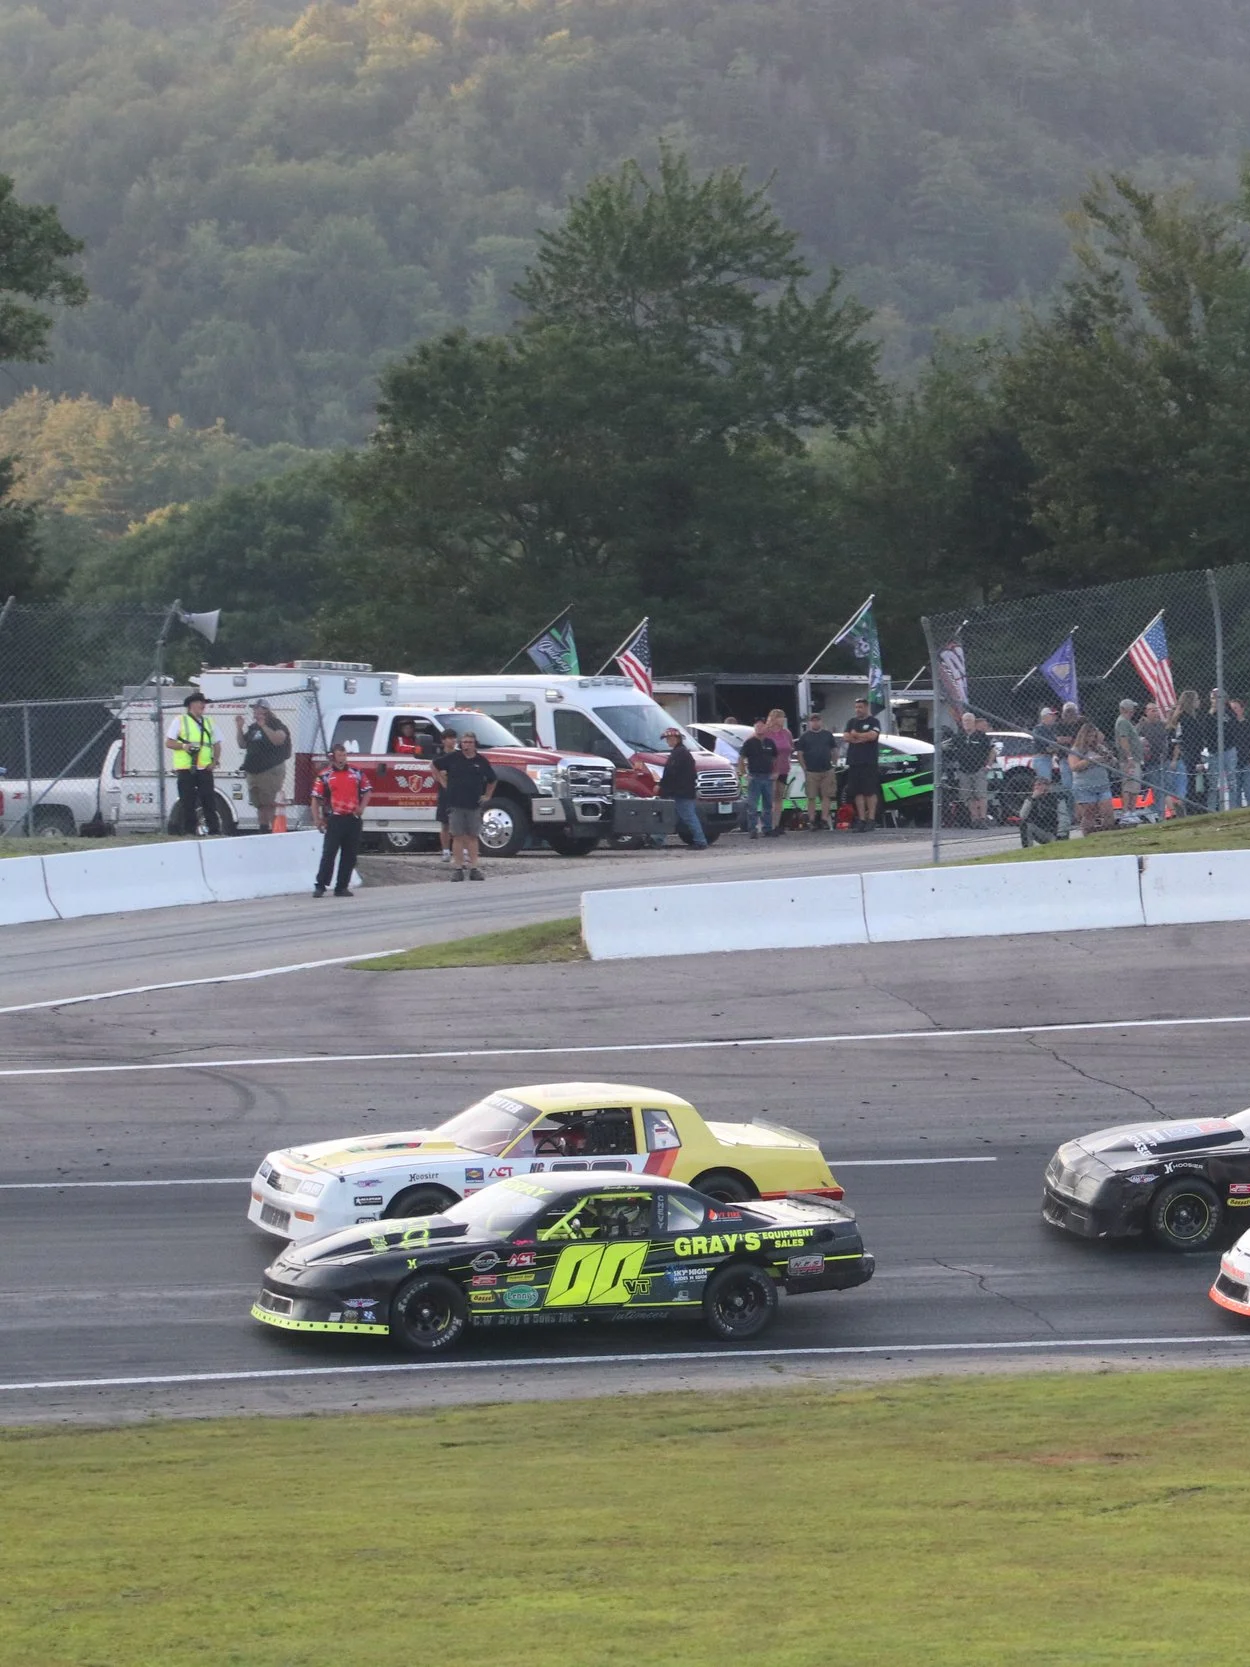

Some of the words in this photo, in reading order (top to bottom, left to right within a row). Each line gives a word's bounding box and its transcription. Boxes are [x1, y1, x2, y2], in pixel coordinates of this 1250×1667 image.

[487, 1166, 515, 1178] ACT
[1173, 1162, 1204, 1170] HOOSIER
[656, 1194, 665, 1229] CHEVY
[674, 1232, 761, 1257] GRAY'S
[762, 1228, 815, 1240] EQUIPMENT
[774, 1238, 805, 1249] SALES
[507, 1252, 537, 1267] ACT
[543, 1240, 652, 1308] 00
[623, 1278, 651, 1295] VT
[507, 1292, 537, 1302] Lenny's
